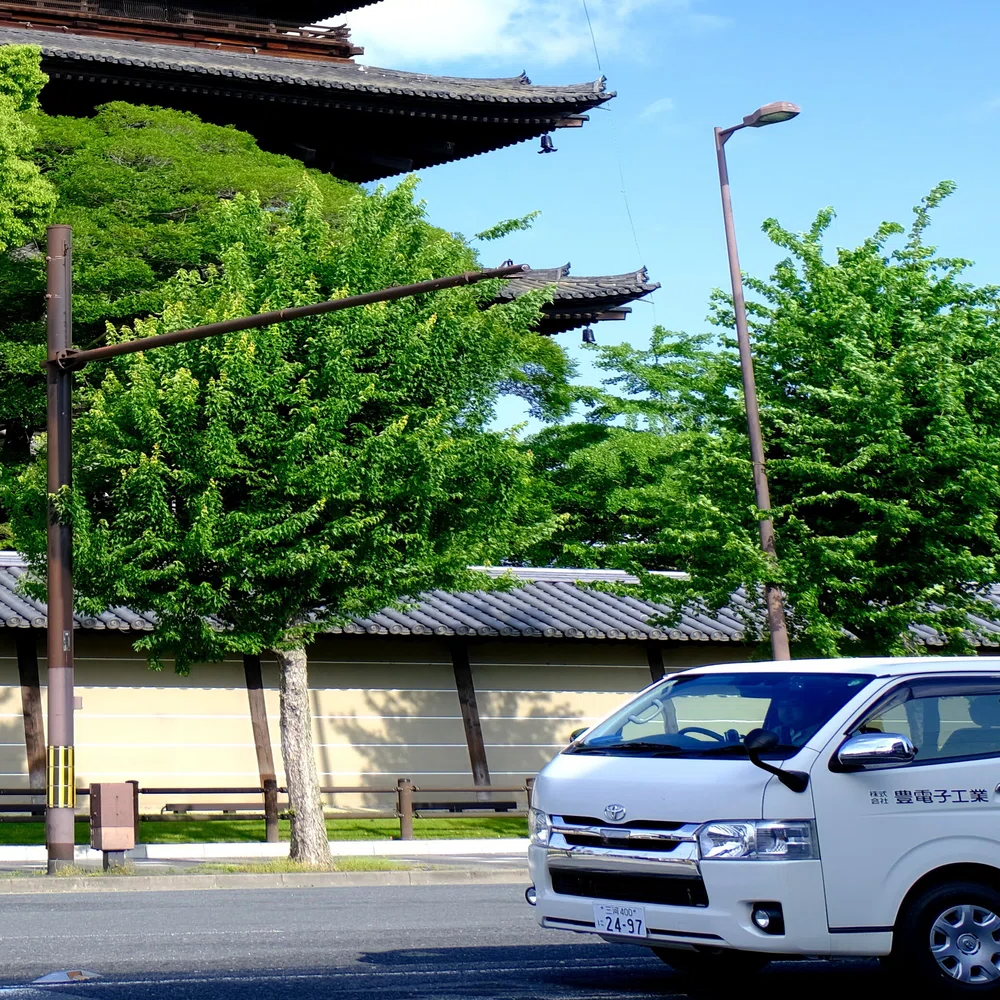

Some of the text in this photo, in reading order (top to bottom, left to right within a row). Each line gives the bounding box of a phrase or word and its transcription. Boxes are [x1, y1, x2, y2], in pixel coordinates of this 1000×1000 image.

[894, 788, 989, 804] 豊電子工業
[606, 916, 642, 934] 24-97
